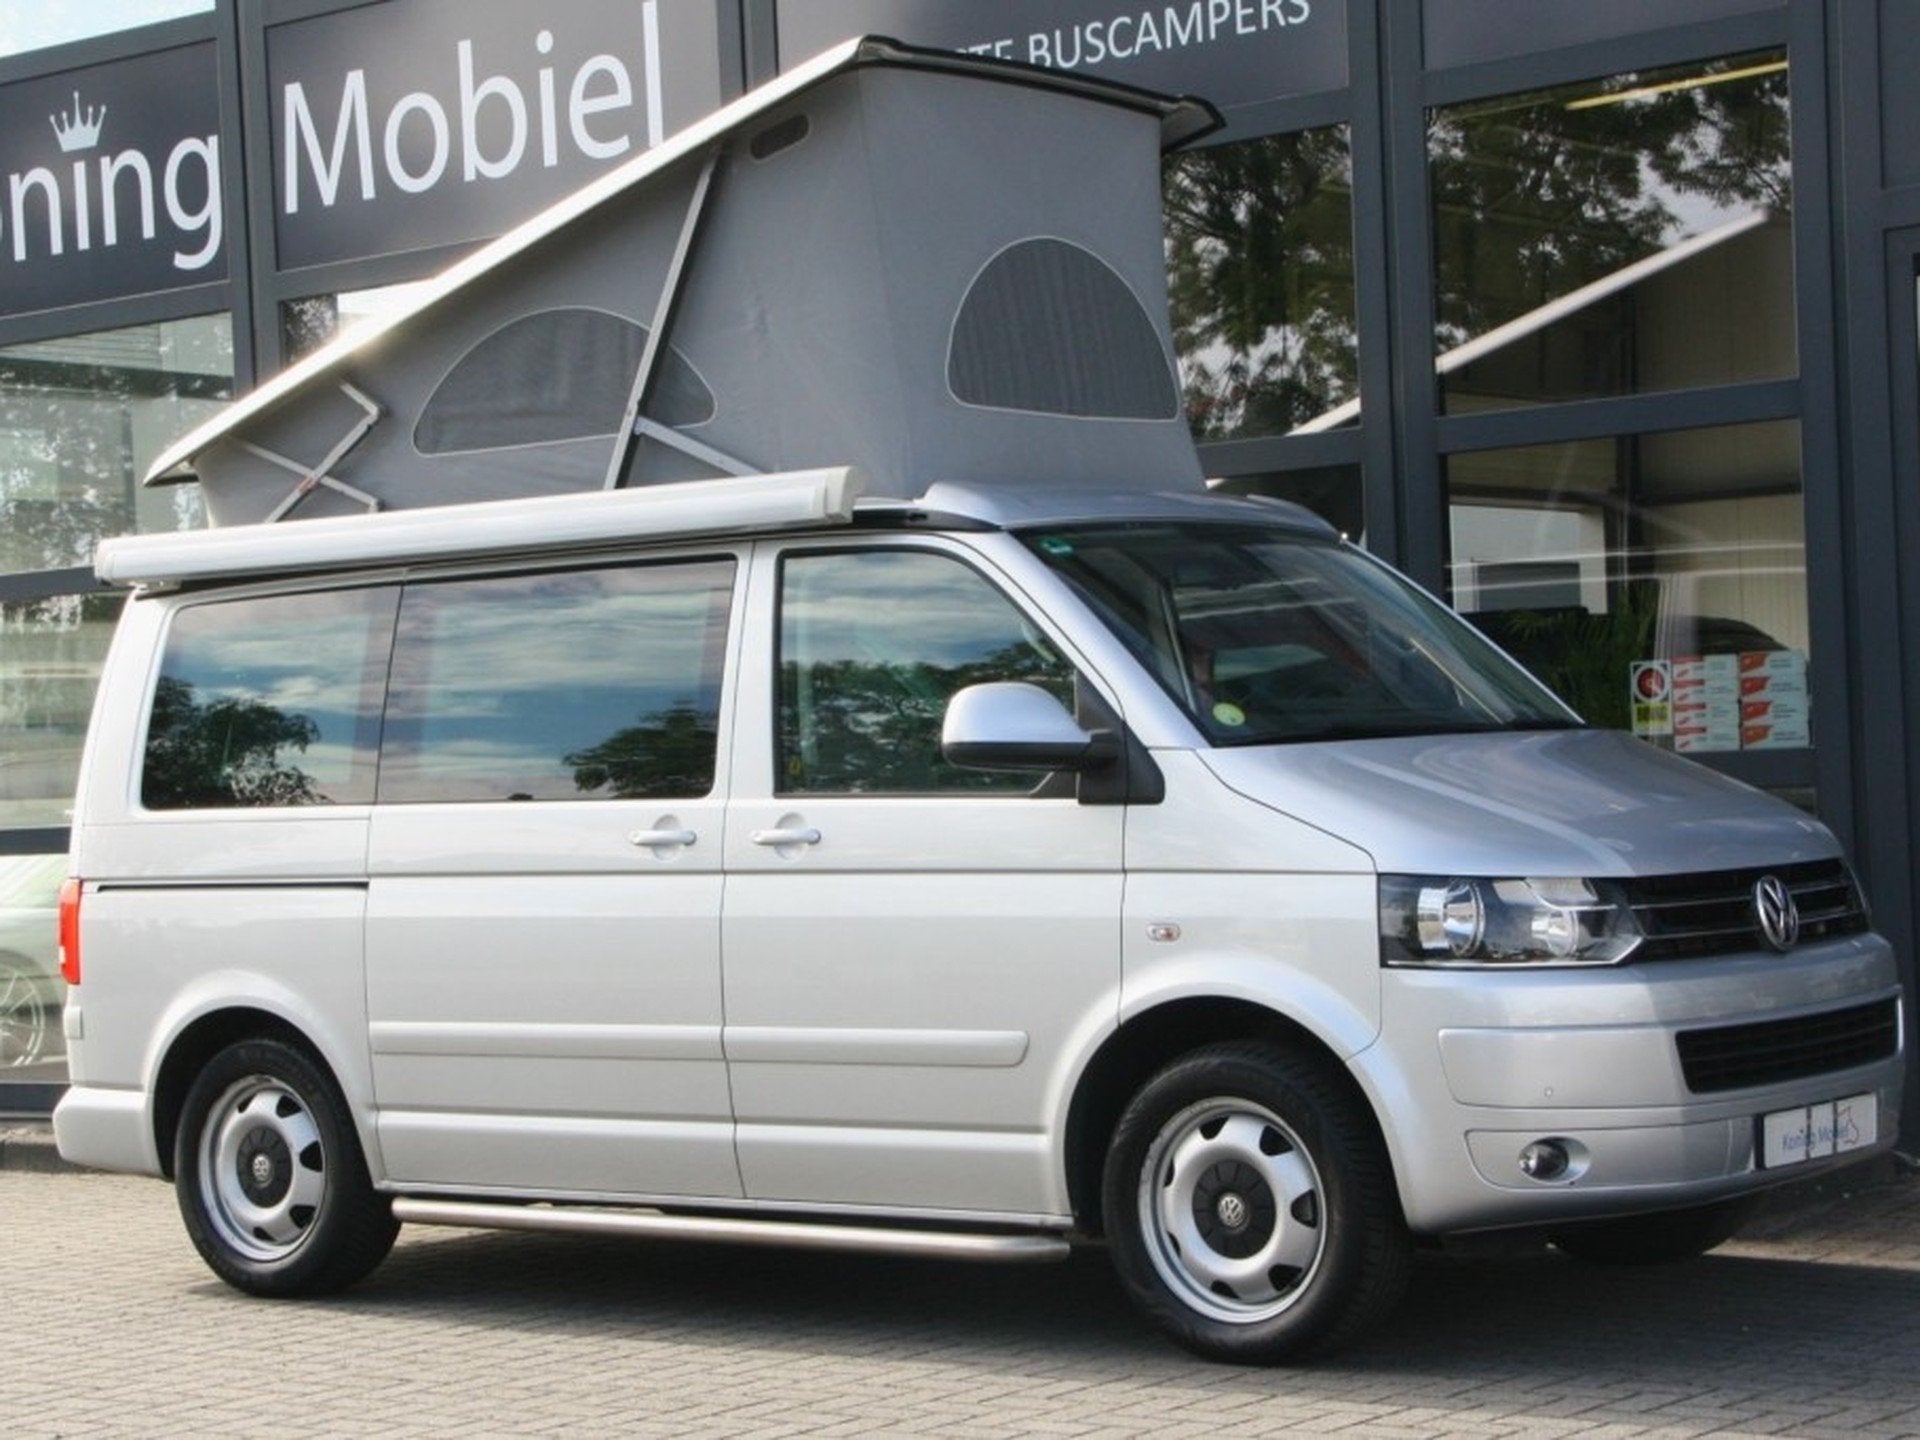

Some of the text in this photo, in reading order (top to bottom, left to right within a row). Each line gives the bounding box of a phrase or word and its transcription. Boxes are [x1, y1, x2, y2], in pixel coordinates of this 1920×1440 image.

[1028, 0, 1310, 68] BUSCAMPERS
[0, 0, 664, 271] ning Mobiel
